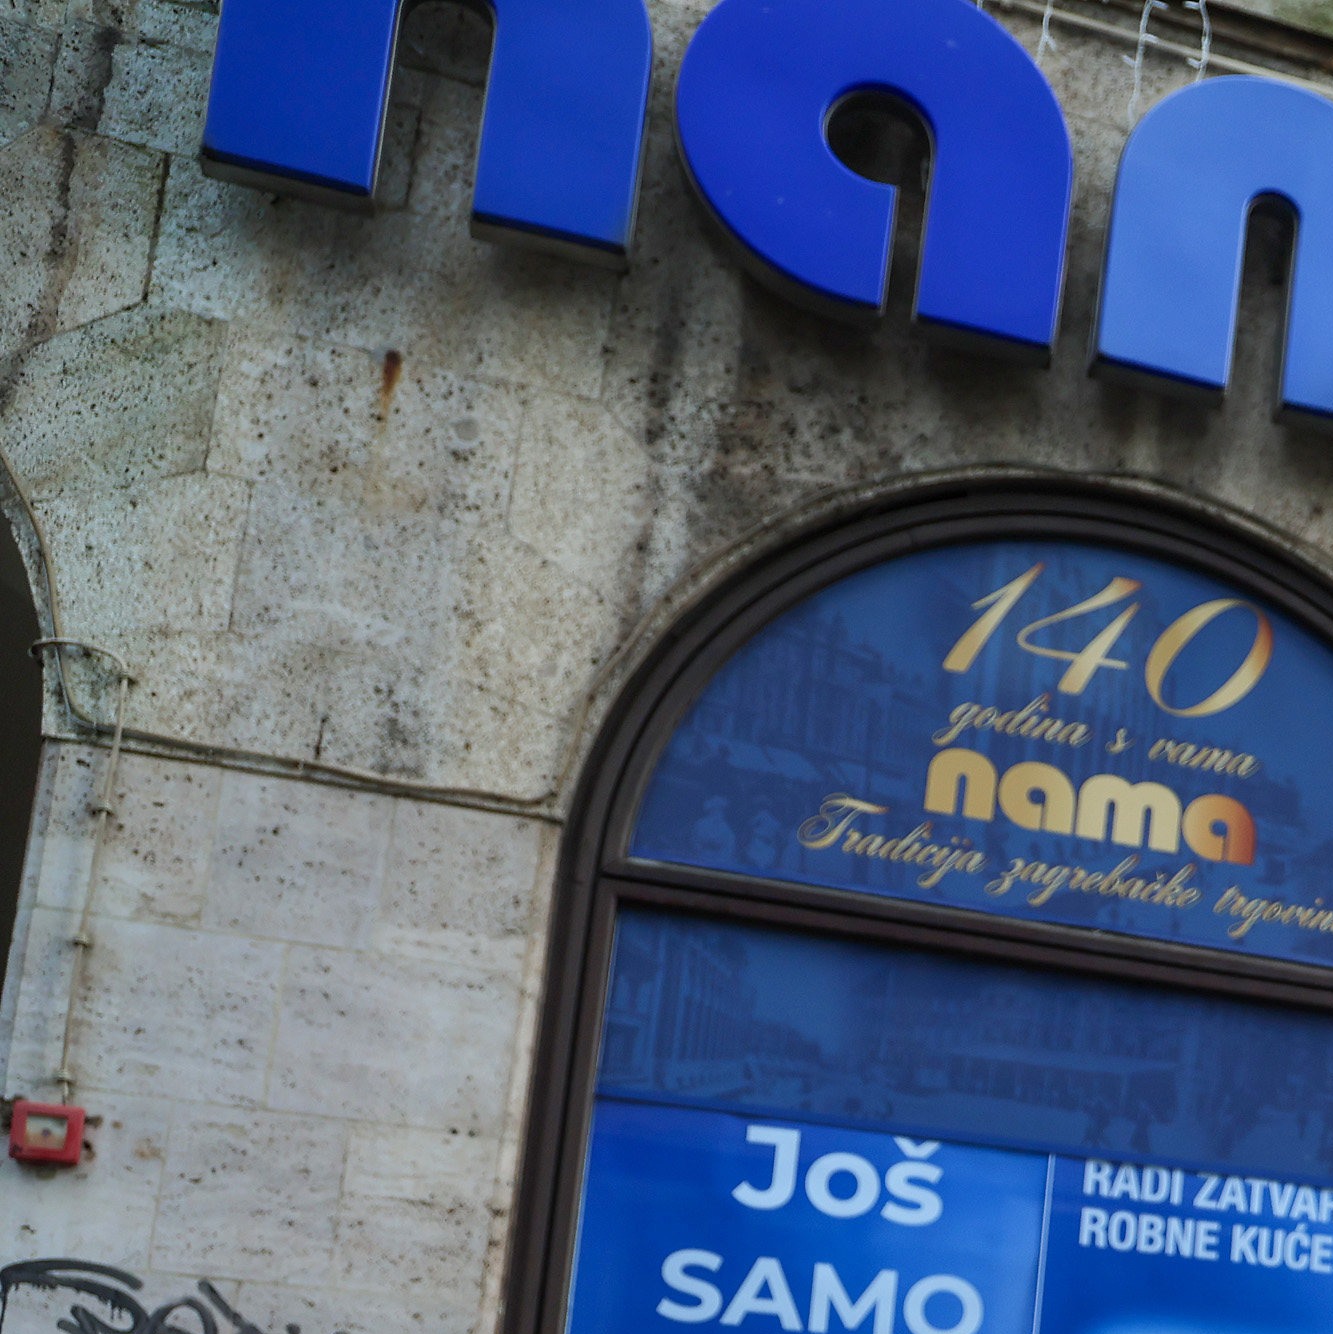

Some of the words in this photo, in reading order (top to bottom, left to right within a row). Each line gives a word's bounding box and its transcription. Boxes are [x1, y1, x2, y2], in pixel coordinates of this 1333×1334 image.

[942, 561, 1274, 718] 140
[932, 693, 1090, 746] godina
[1107, 724, 1130, 753] s
[1148, 736, 1261, 779] vama
[797, 792, 987, 888] Tradicija
[985, 851, 1201, 907] zagrebačke
[924, 746, 1256, 866] nama
[1083, 1158, 1185, 1205] RADI
[1079, 1207, 1219, 1262] ROBNE
